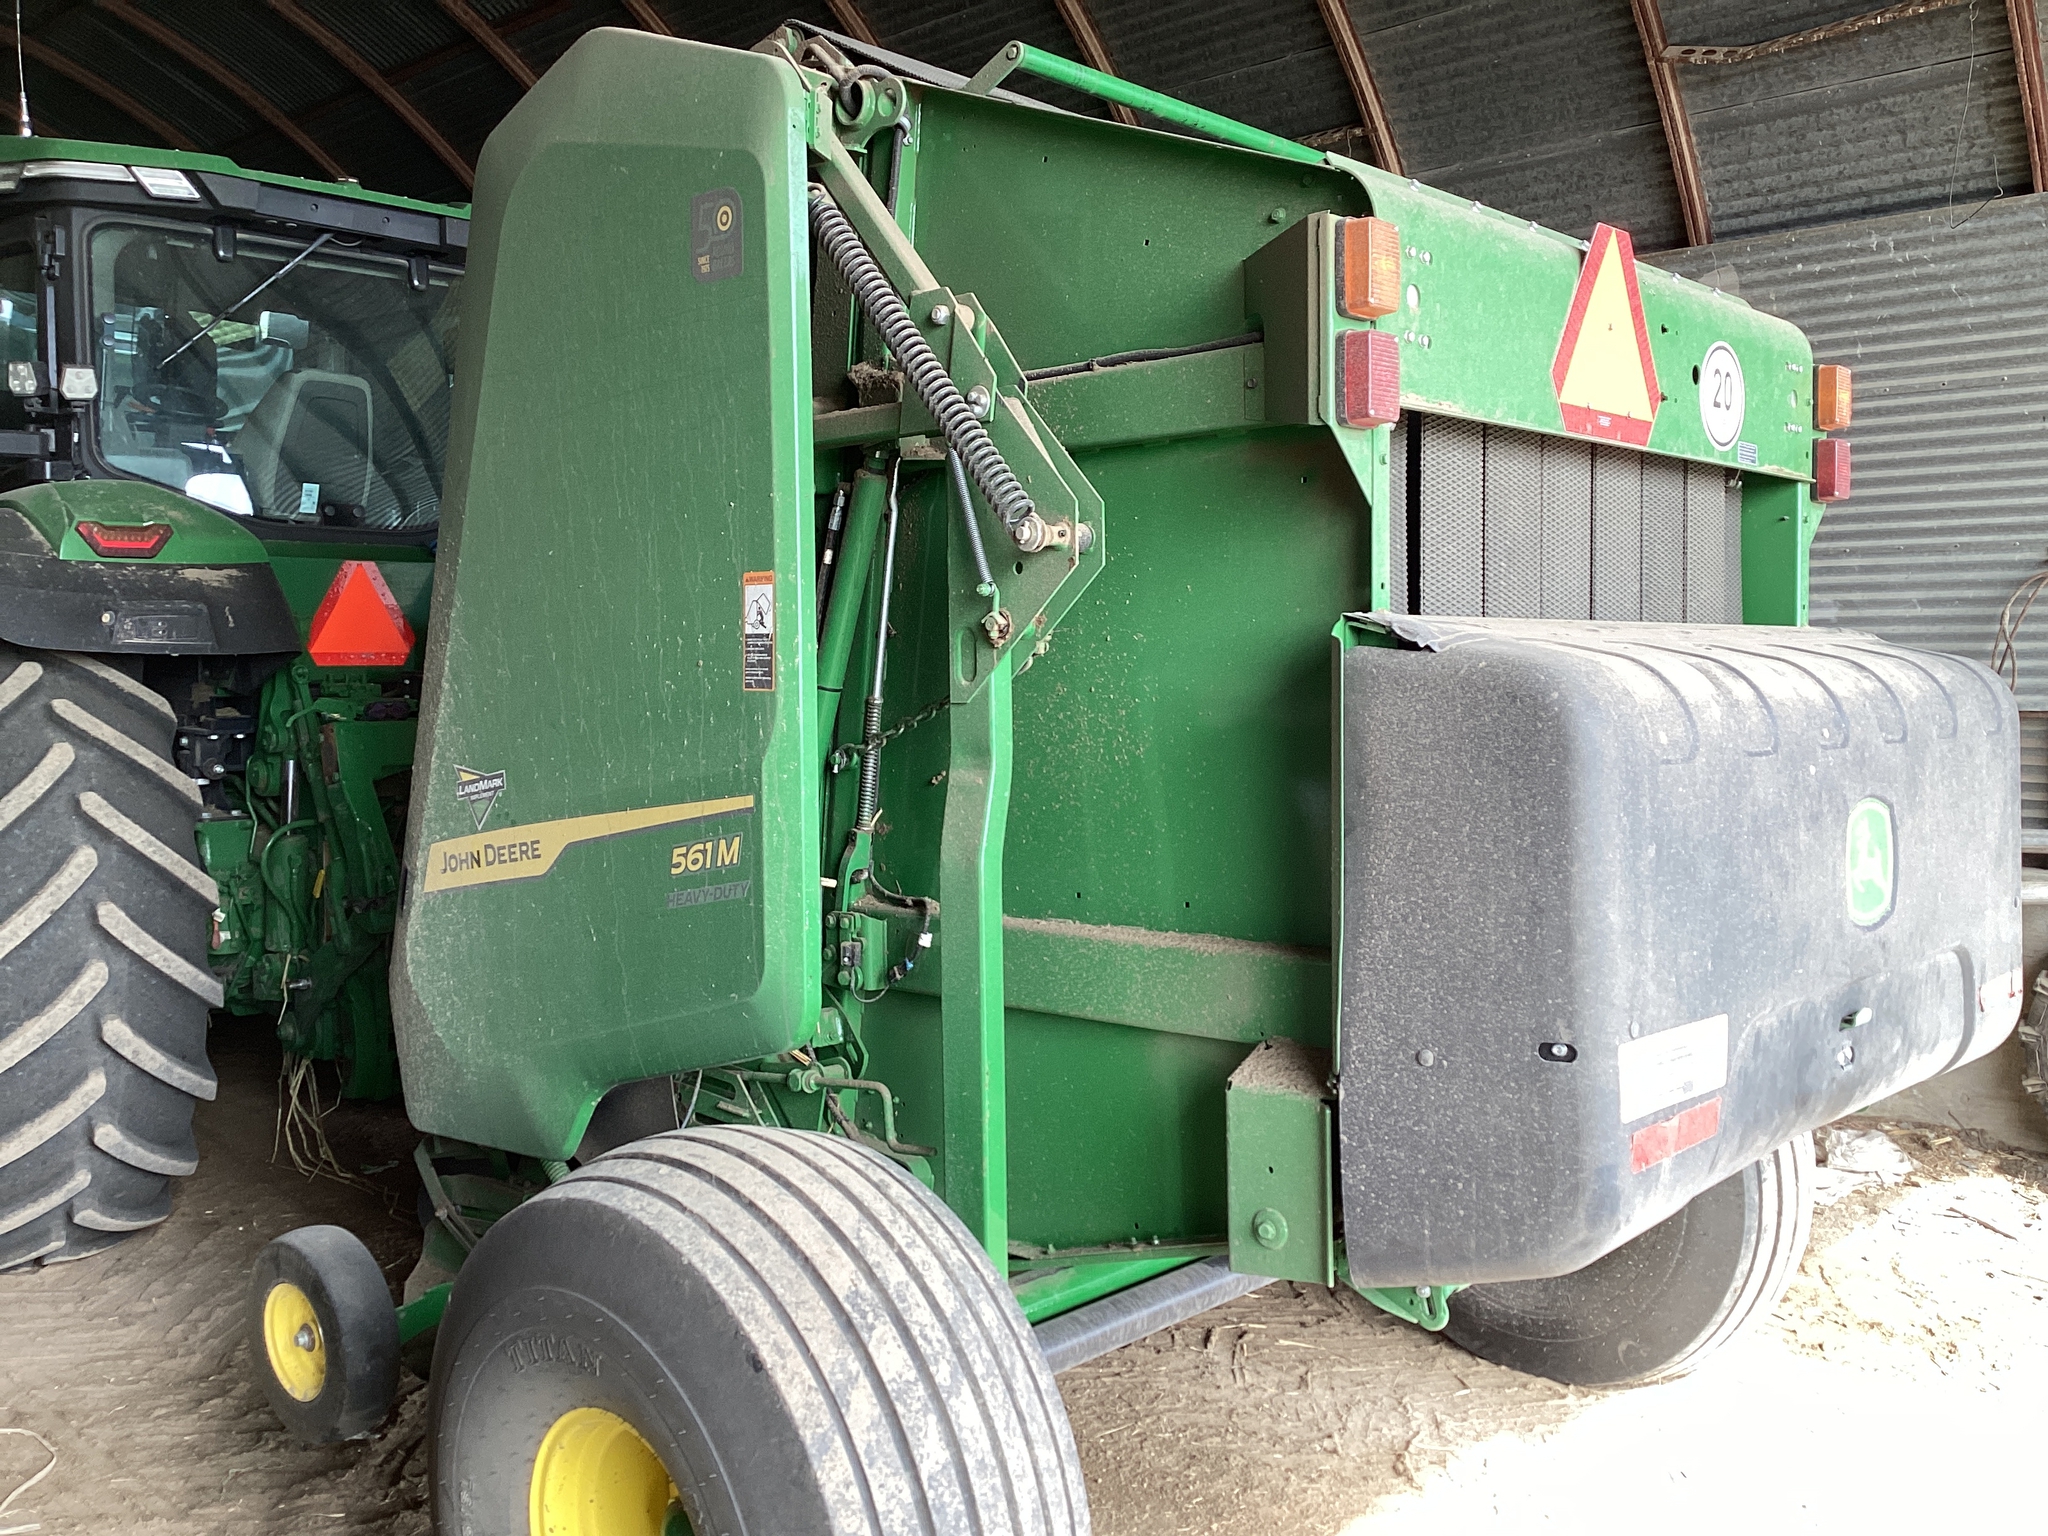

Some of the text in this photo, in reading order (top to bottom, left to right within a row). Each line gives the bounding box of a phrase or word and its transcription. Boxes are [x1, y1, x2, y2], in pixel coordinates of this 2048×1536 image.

[1713, 368, 1733, 411] 20
[458, 777, 503, 796] LANDMARK
[441, 839, 542, 874] JOHN DEERE
[667, 880, 749, 907] HEAVY-DUTY
[507, 1332, 602, 1377] TITAN
